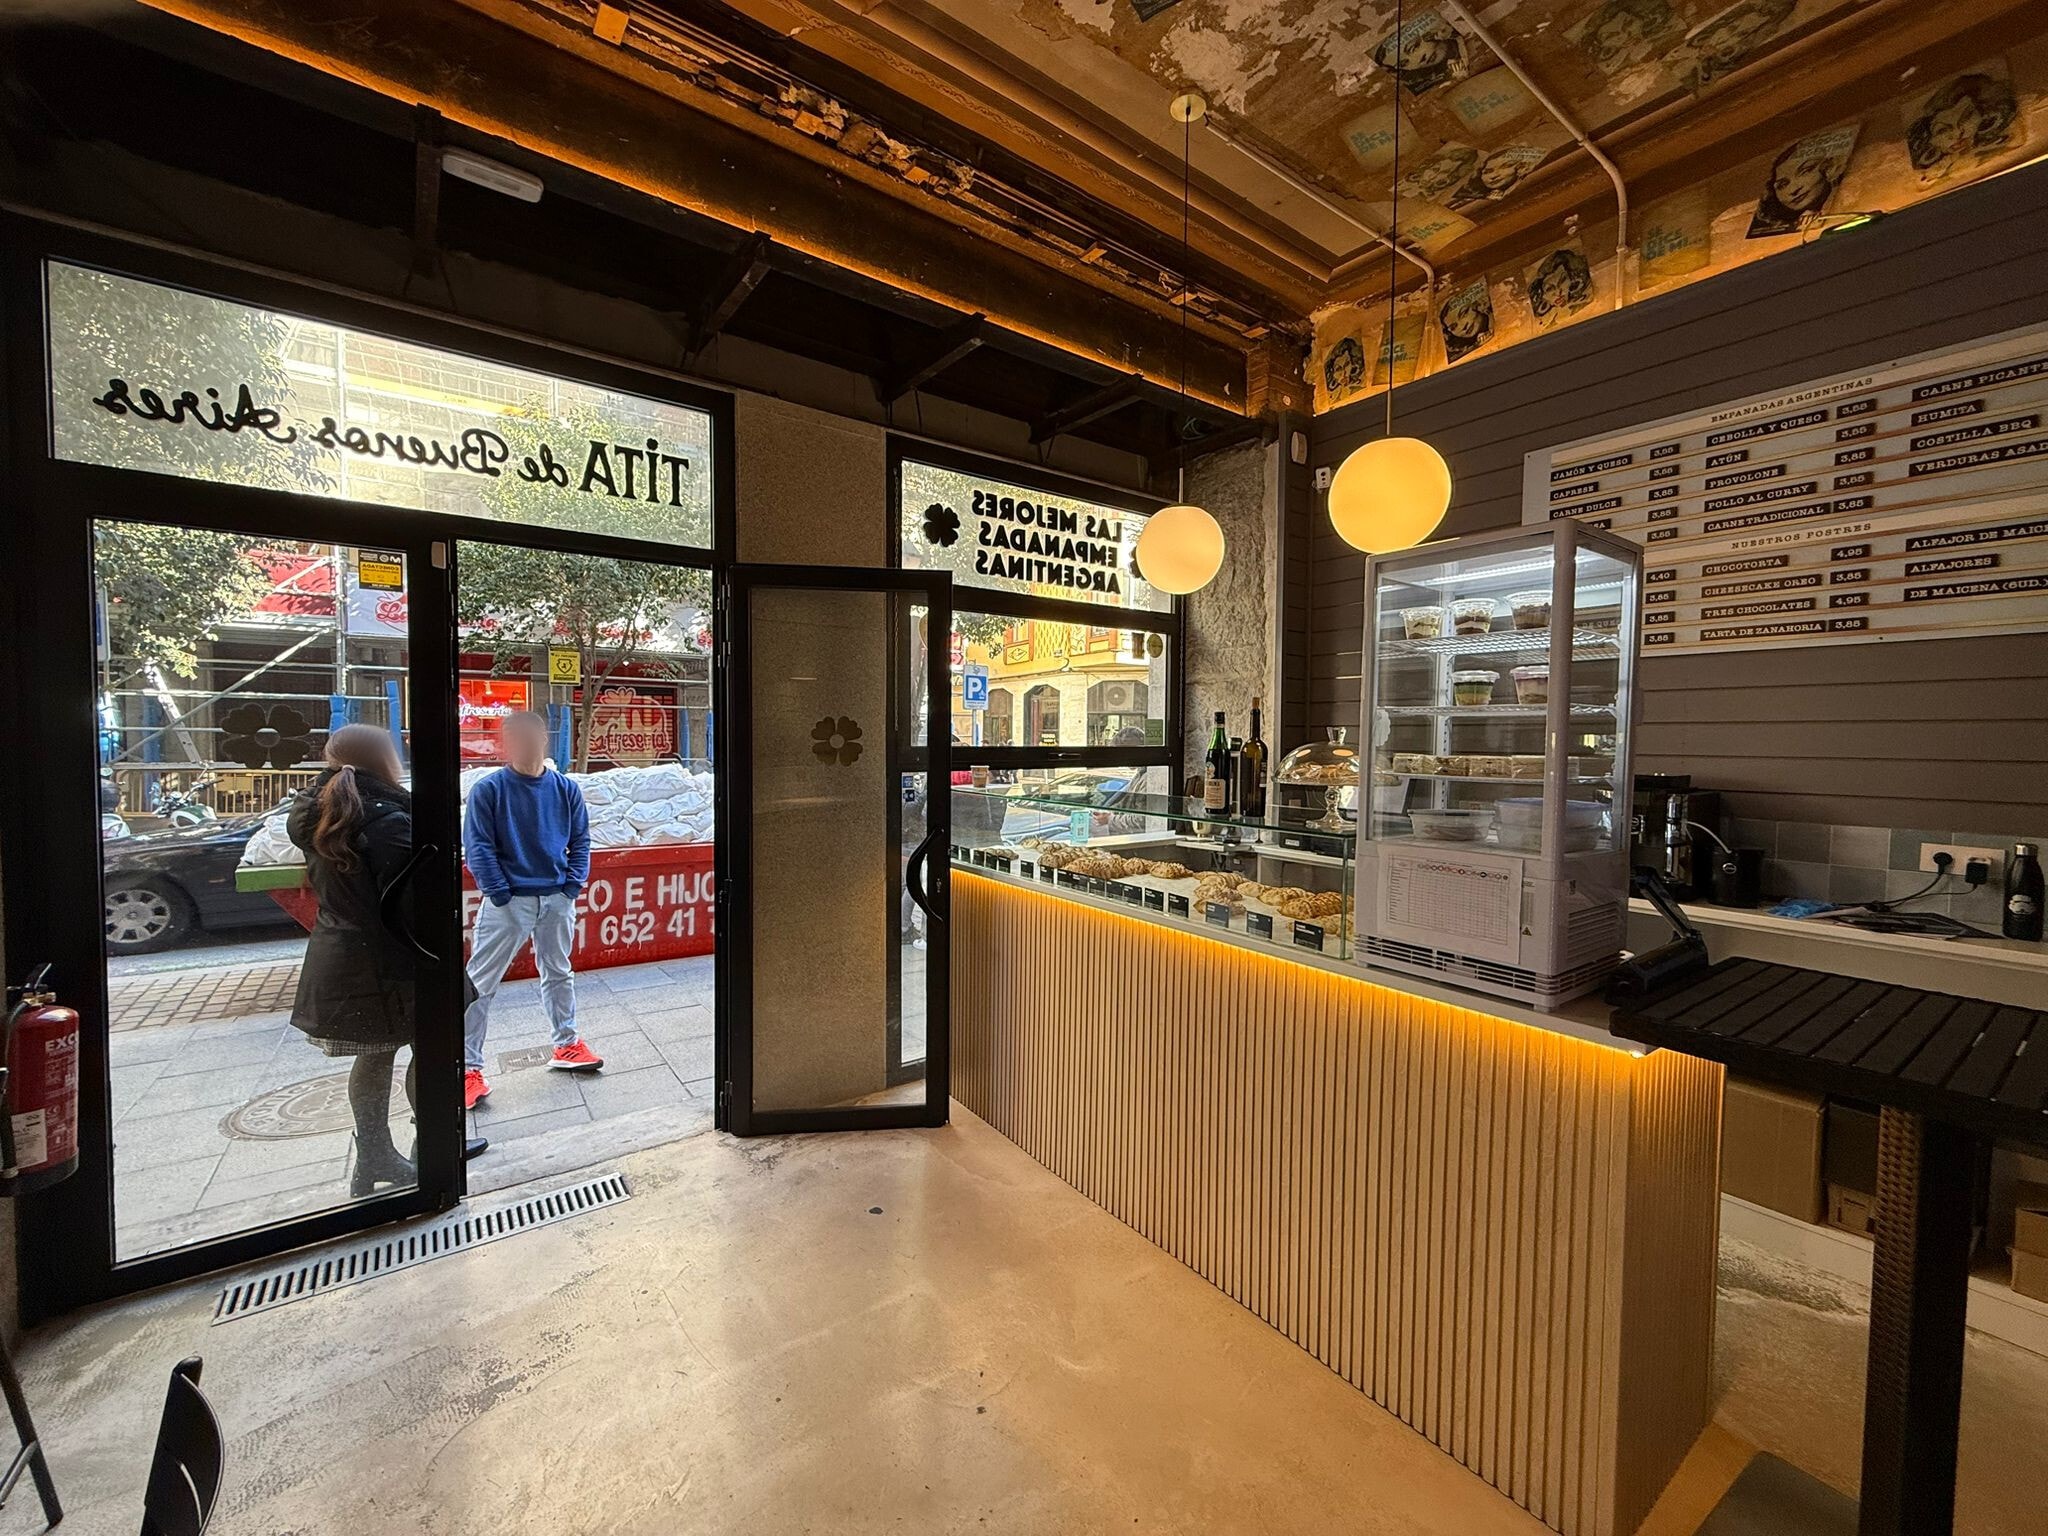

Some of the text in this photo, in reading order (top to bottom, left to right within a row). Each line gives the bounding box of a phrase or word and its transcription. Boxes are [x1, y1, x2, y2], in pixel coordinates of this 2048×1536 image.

[1919, 379, 1973, 398] CARNE
[1711, 377, 1873, 423] EMPANADAS ARGENTINAS
[1917, 404, 1977, 423] HUMITA
[1711, 426, 1765, 445] CEBOLLA
[1769, 424, 1777, 432] Y
[1780, 413, 1822, 430] QUESO
[1916, 419, 2032, 448] COSTILLA BBQ
[1553, 465, 1586, 481] JAMÓN
[1588, 464, 1595, 472] Y
[1597, 457, 1628, 471] QUESO
[1915, 450, 2000, 472] VERDURAS
[1709, 468, 1779, 488] PROVOLONE
[1553, 485, 1595, 500] CAPRESE
[1708, 496, 1744, 510] POLLO
[1747, 494, 1764, 502] AL
[1766, 485, 1810, 499] CURRY
[1552, 506, 1584, 519] CARNE
[1586, 500, 1617, 512] DULCE
[1707, 518, 1745, 532] CARNE
[1745, 506, 1824, 526] TRADICIONAL
[1731, 523, 1872, 549] NUESTROS POSTRES
[1911, 534, 1975, 549] ALFAJOR
[1979, 531, 1998, 540] DE
[1705, 558, 1782, 575] CHOCOTORTA
[1910, 557, 1992, 573] ALFAJORES
[1704, 581, 1780, 597] CHEESECAKE
[1783, 577, 1816, 588] OREO
[1909, 590, 1928, 599] DE
[1932, 582, 2000, 597] MAICENA
[1704, 608, 1734, 618] TRES
[1736, 600, 1811, 615] CHOCOLATES
[1703, 629, 1737, 639] TARTA
[1739, 627, 1754, 637] DE
[1755, 622, 1822, 636] ZANAHORIA
[968, 677, 983, 699] P
[626, 877, 645, 910] E
[601, 911, 655, 946] 652
[667, 907, 695, 937] 41
